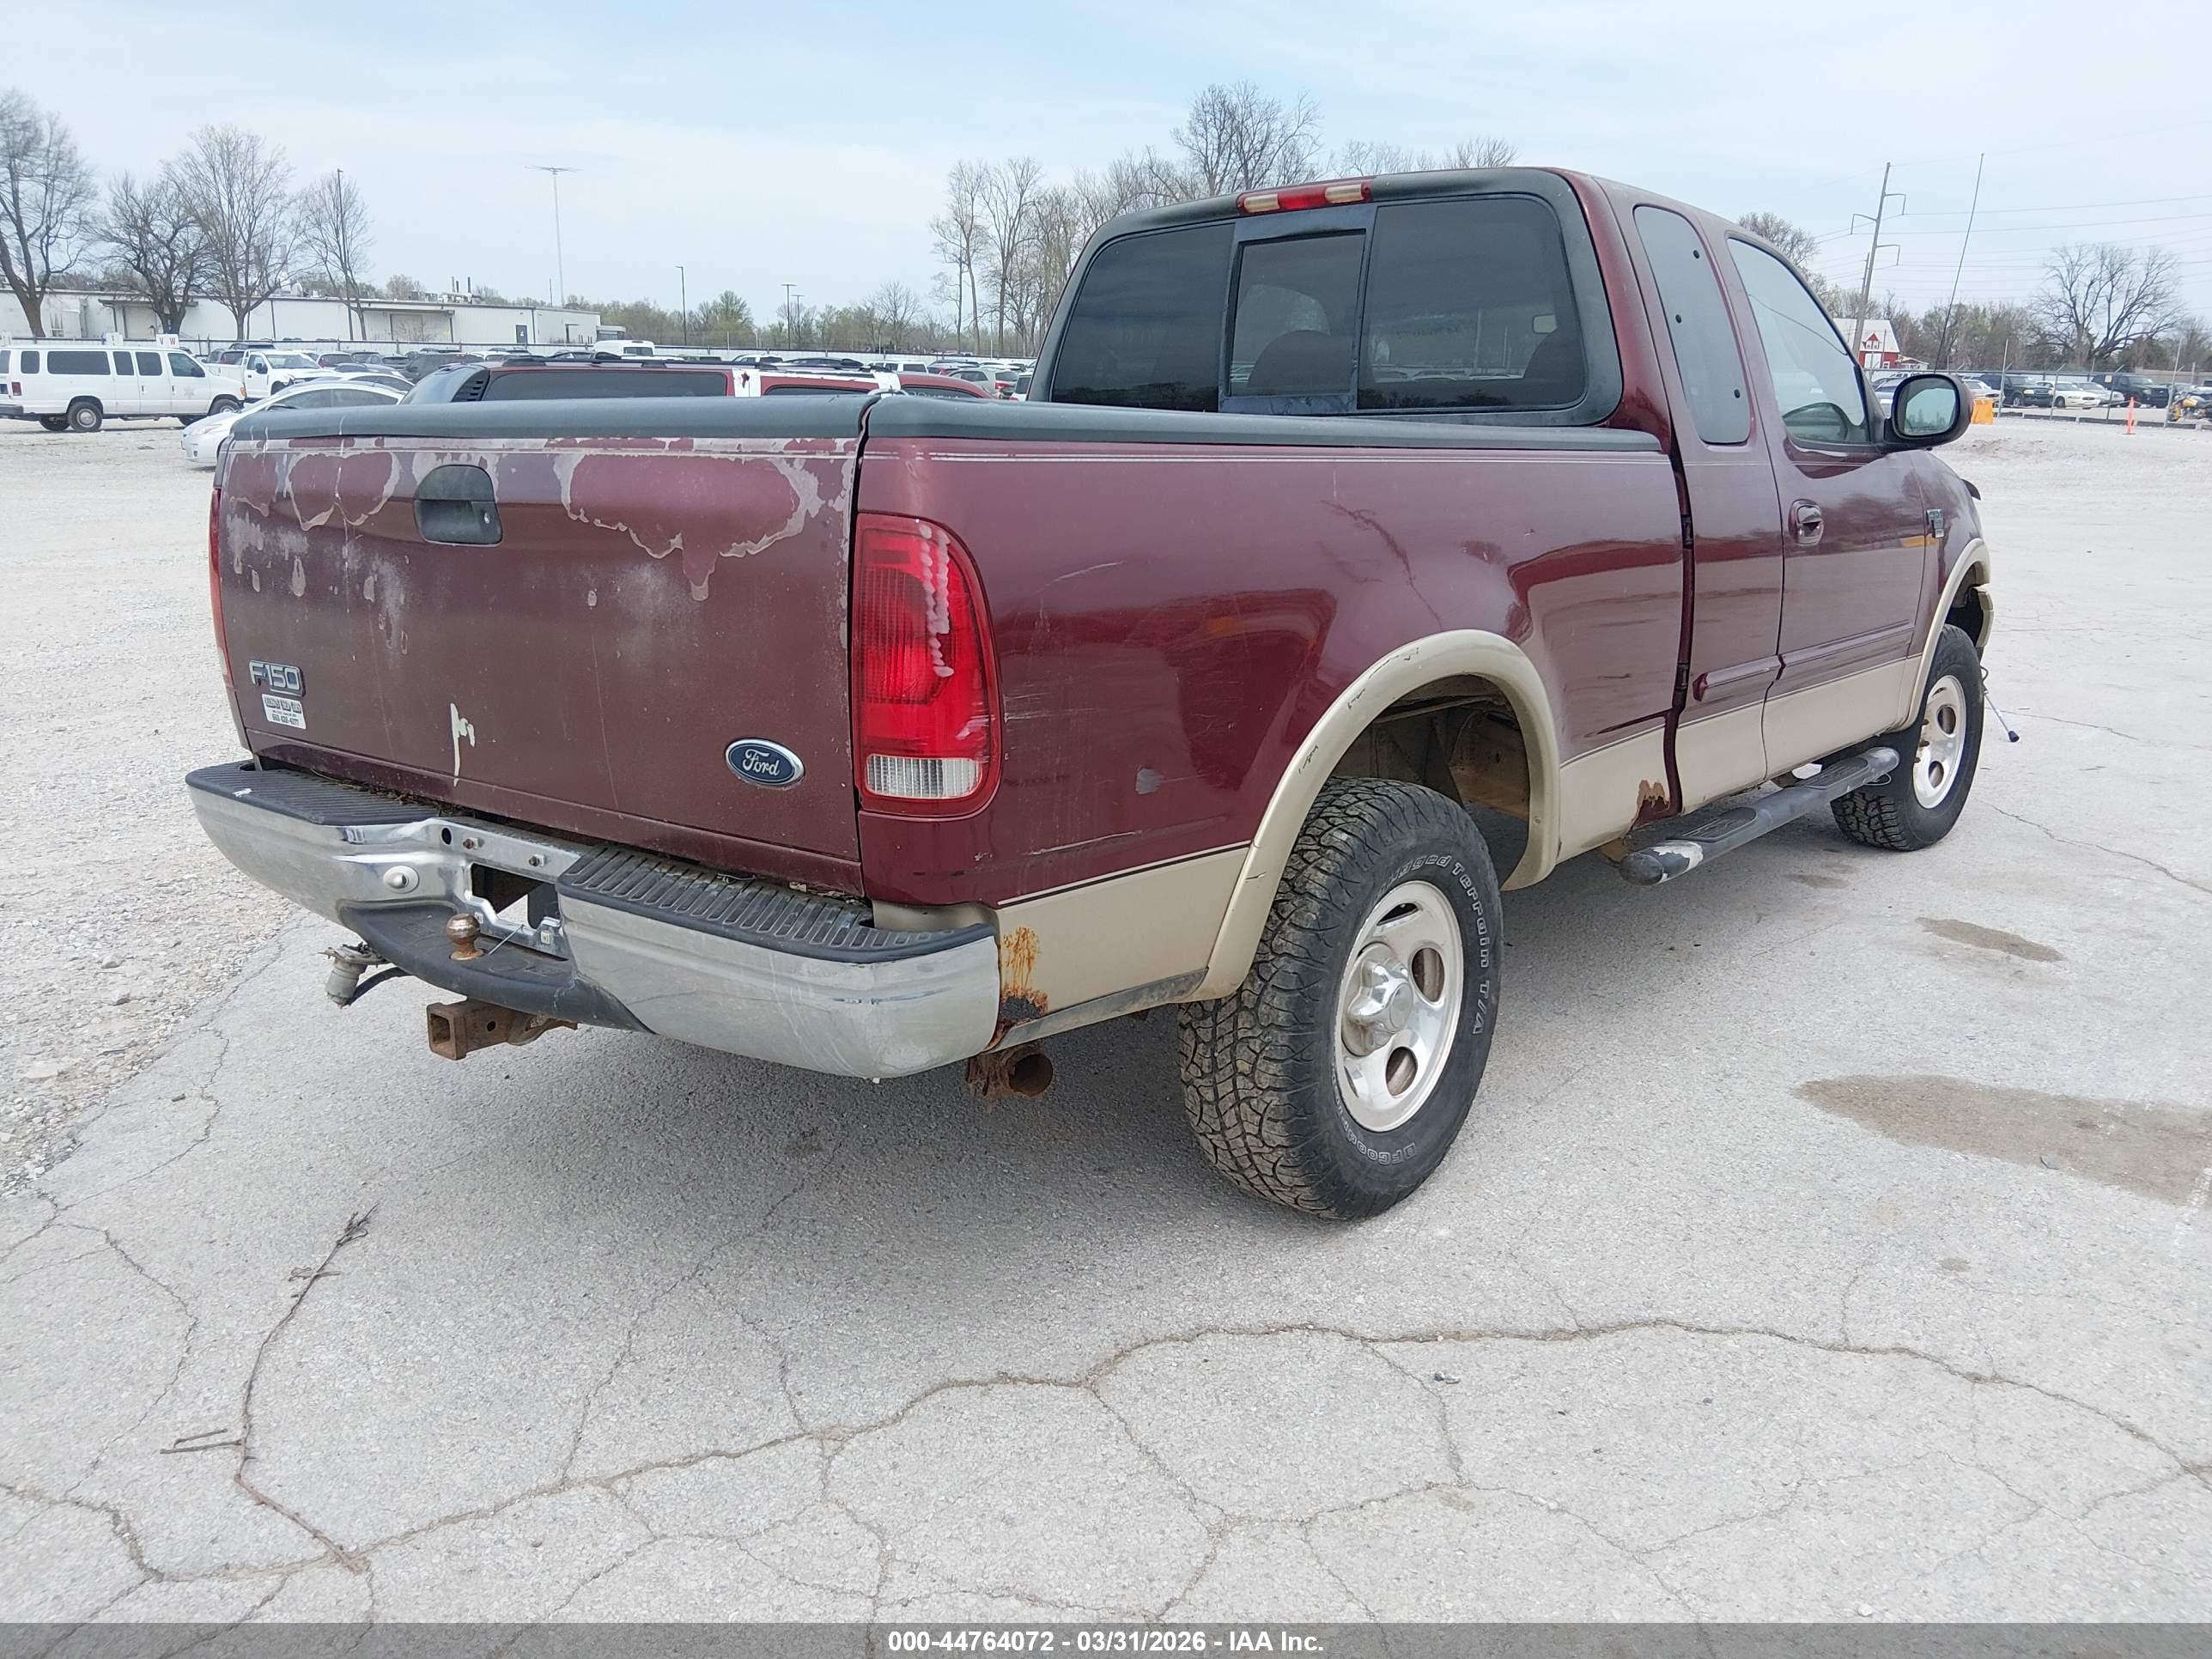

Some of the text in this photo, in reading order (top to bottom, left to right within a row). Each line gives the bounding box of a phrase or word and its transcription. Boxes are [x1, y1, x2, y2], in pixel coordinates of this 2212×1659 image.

[742, 749, 780, 776] Ford
[1452, 862, 1491, 968] Terrain
[1472, 980, 1491, 1035] T/A
